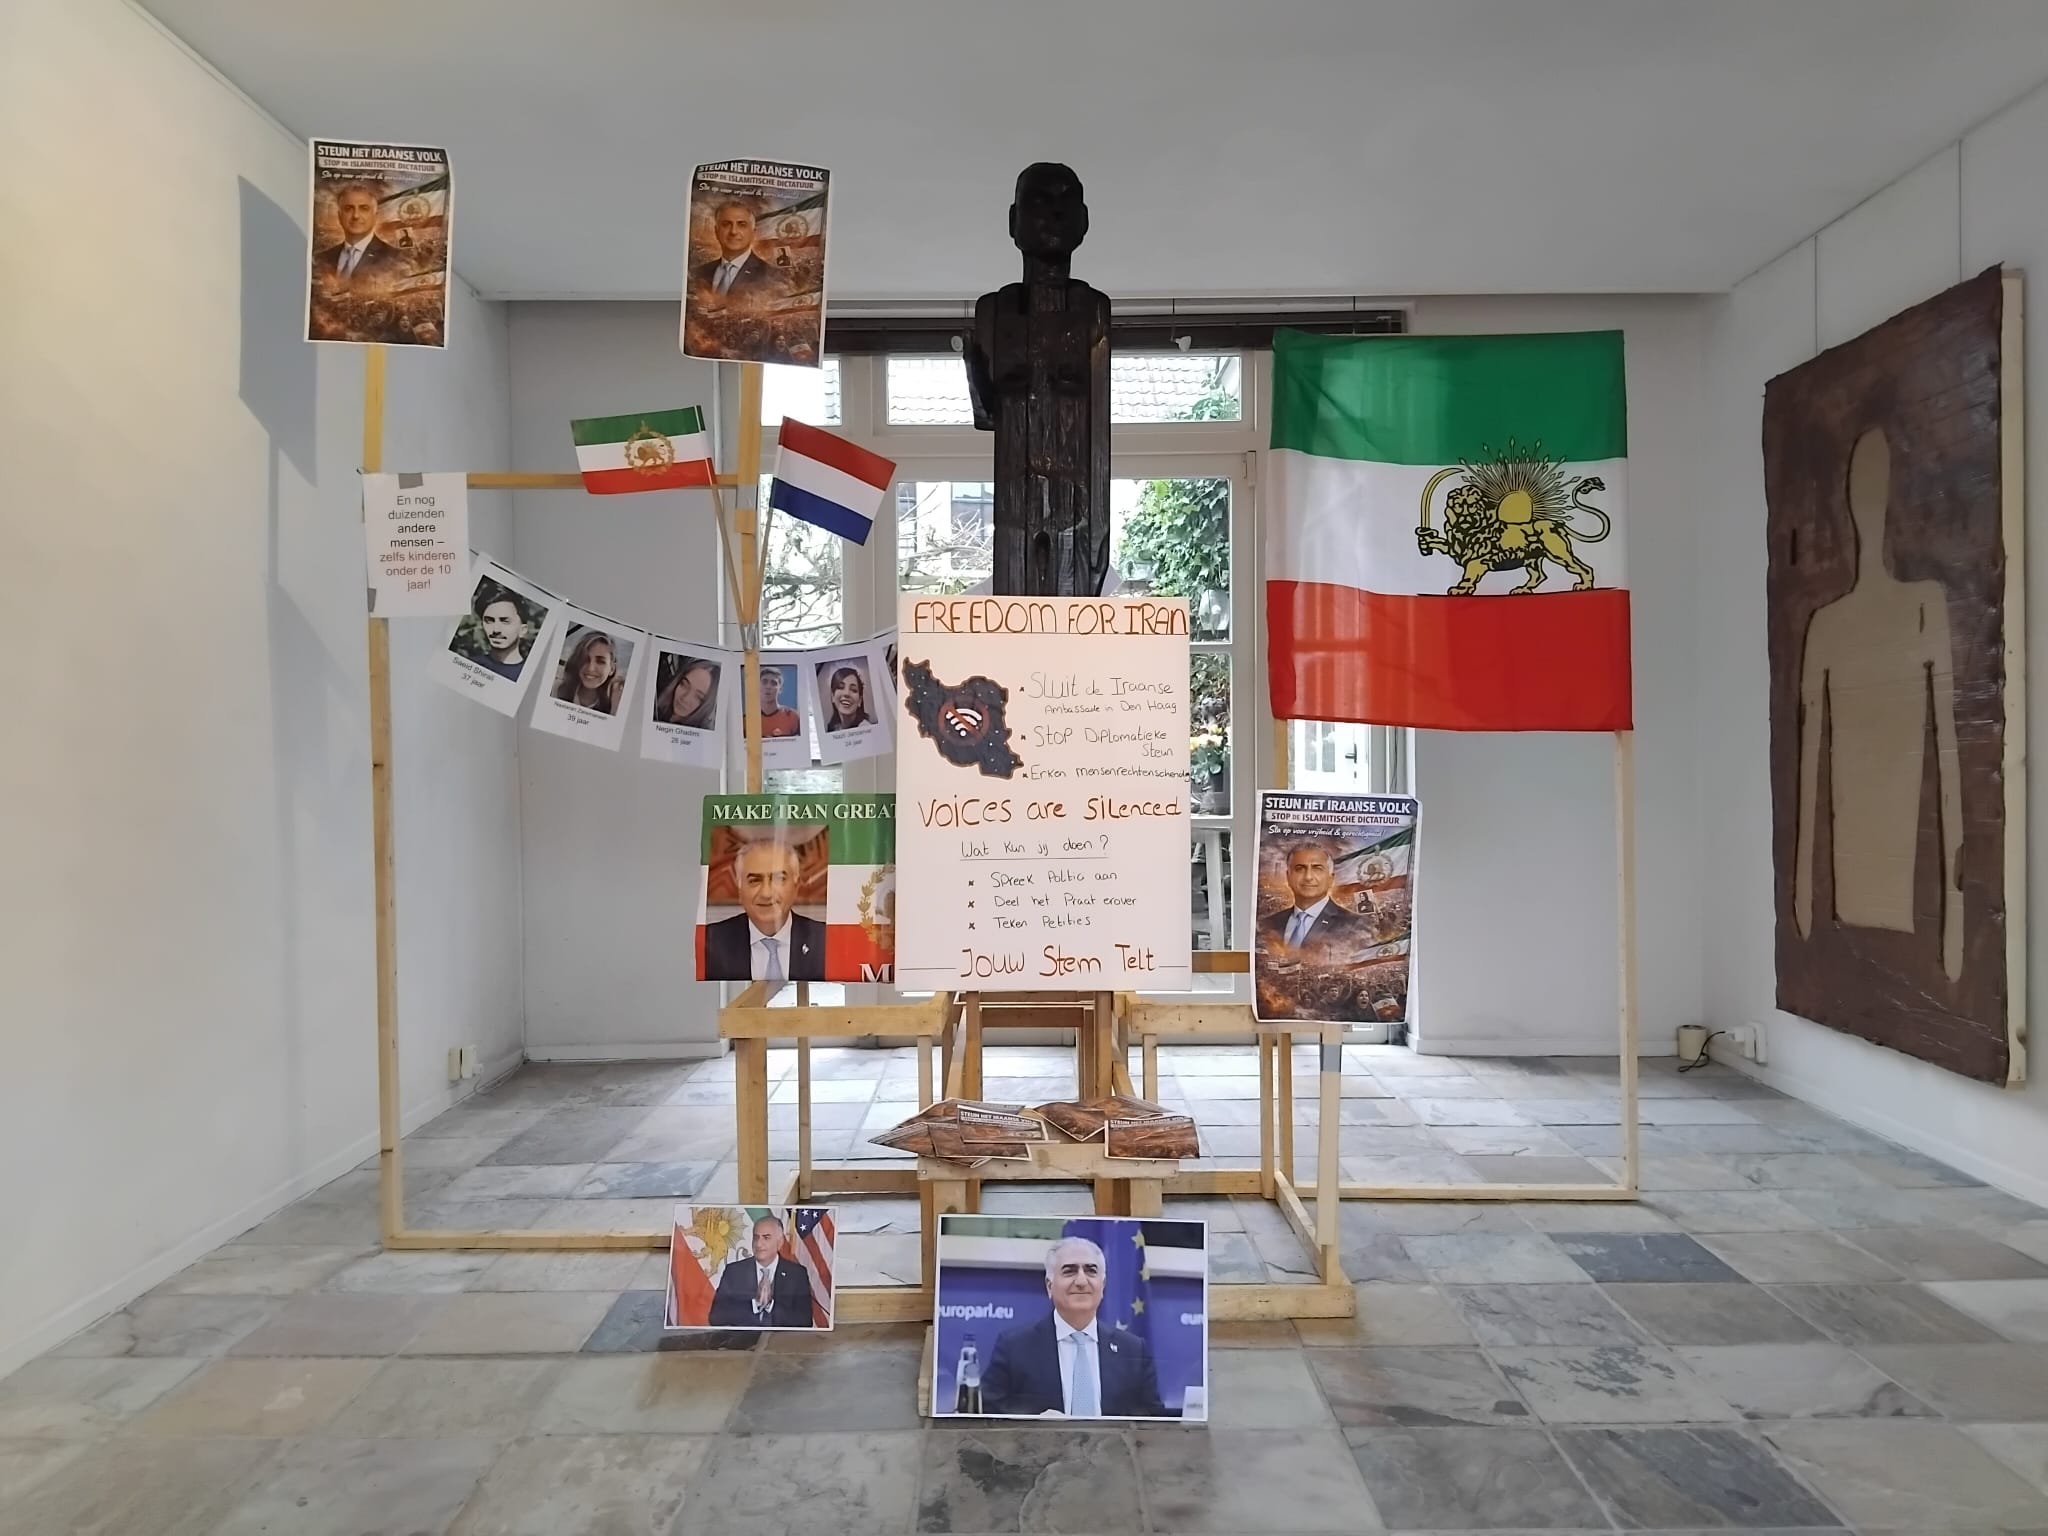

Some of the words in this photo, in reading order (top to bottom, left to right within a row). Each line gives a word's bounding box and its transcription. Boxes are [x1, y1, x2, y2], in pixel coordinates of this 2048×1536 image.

[318, 145, 349, 157] STEUN
[352, 148, 370, 158] HET
[372, 148, 414, 160] IRAANSE
[416, 151, 442, 162] VOLK
[350, 161, 396, 169] ISLAMITISCHE
[398, 163, 435, 171] DICTATUUR
[699, 163, 729, 172] STEUN
[730, 163, 749, 173] HET
[750, 164, 793, 178] IRAANSE
[796, 169, 823, 180] VOLK
[729, 175, 775, 186] ISLAMITISCHE
[777, 180, 814, 189] DICTATUUR
[397, 495, 411, 505] En
[414, 496, 435, 506] nog
[388, 509, 445, 520] duizenden
[397, 523, 436, 533] andere
[390, 538, 434, 548] mensen
[379, 552, 405, 562] zelfs
[408, 551, 456, 561] kinderen
[386, 566, 417, 576] onder
[421, 565, 434, 575] de
[439, 565, 451, 574] 10
[407, 579, 431, 592] jaar!
[914, 599, 1057, 634] FREEDOM
[1068, 603, 1119, 635] FOR
[1123, 602, 1188, 636] IRAN
[470, 680, 485, 688] jaar
[1028, 672, 1079, 699] Sluit
[1085, 679, 1104, 696] de
[1110, 677, 1173, 696] Iraanse
[1044, 704, 1101, 714] Ambassade
[1120, 700, 1141, 712] Den
[1147, 699, 1177, 714] Haag
[1142, 743, 1174, 758] Steun
[1030, 764, 1067, 781] Erken
[712, 804, 772, 820] MAKE
[779, 804, 828, 820] IRAN
[1026, 800, 1067, 820] are
[1265, 797, 1301, 809] STEUN
[1304, 799, 1325, 811] HET
[1327, 800, 1375, 813] IRAANSE
[1379, 802, 1410, 814] VOLK
[1302, 814, 1356, 823] ISLAMITISCHE
[1359, 816, 1399, 824] DICTATUUR
[1268, 825, 1281, 834] Sta
[1283, 828, 1291, 836] op
[961, 841, 990, 858] Wat
[1094, 872, 1118, 881] aan
[994, 895, 1020, 908] Deel
[1031, 893, 1049, 907] het
[1064, 892, 1096, 906] Praat
[1103, 897, 1137, 906] erover
[992, 917, 1028, 929] Teken
[1042, 914, 1091, 929] Petities
[1039, 945, 1102, 977] Stem
[1114, 943, 1157, 972] Telt
